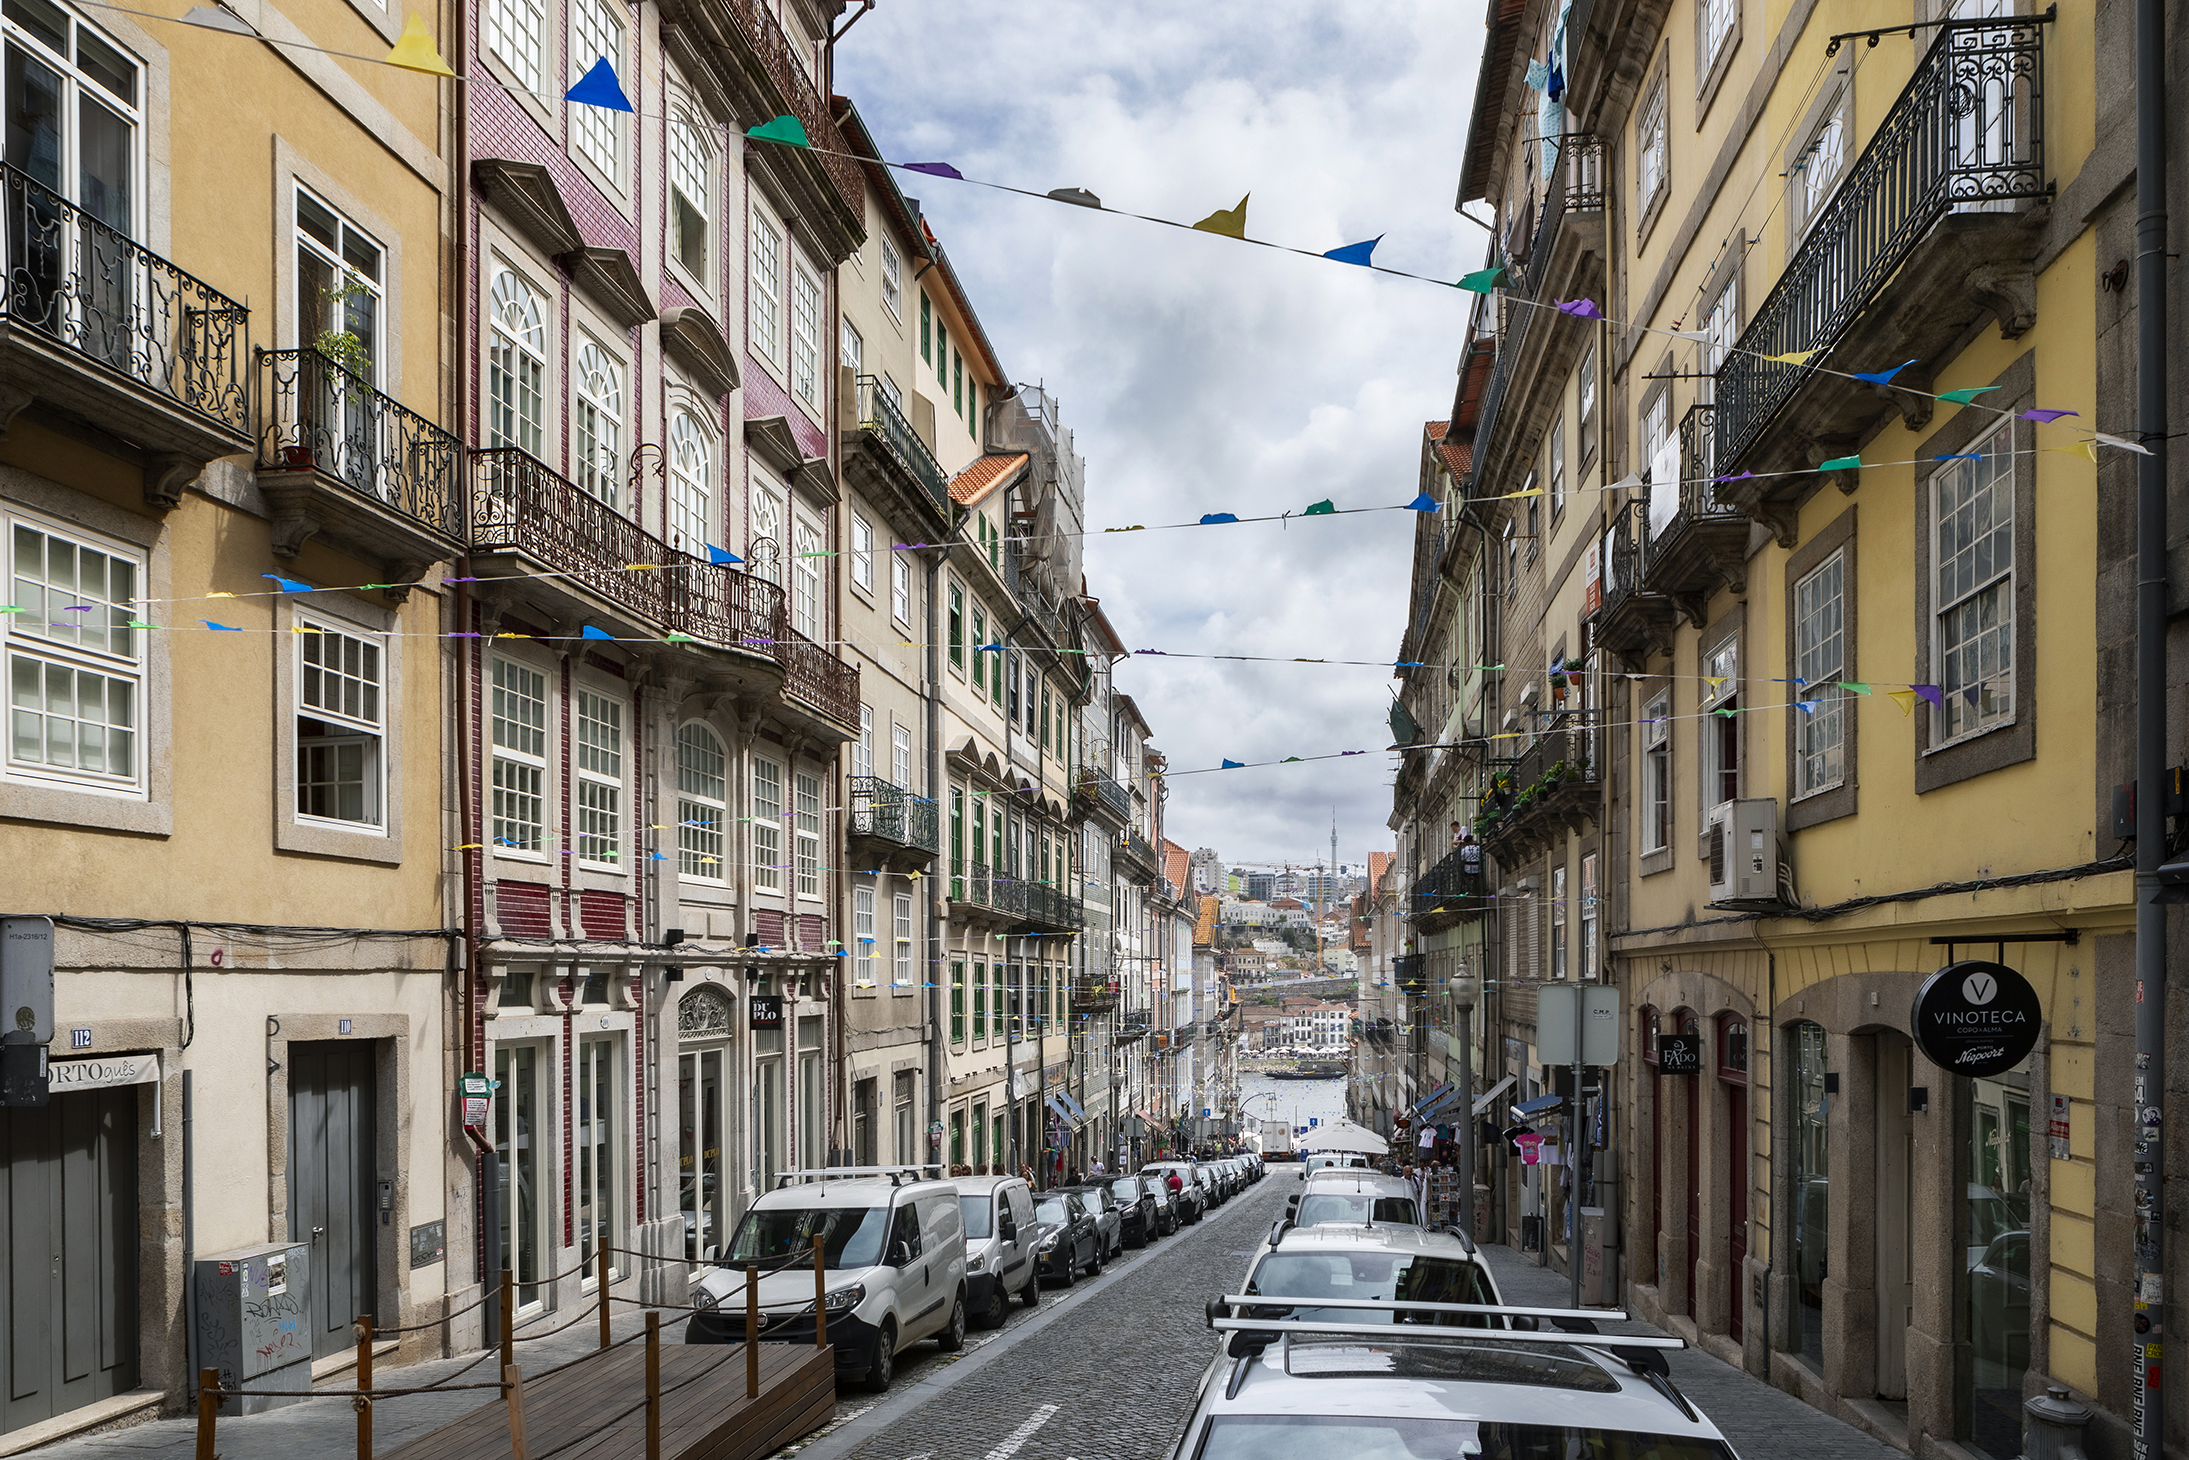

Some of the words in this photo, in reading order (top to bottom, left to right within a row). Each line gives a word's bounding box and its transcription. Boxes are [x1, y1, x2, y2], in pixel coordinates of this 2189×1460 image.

[9, 933, 48, 941] H1a-2316/12
[1970, 979, 1990, 1002] V
[753, 1003, 770, 1012] DU
[753, 1011, 777, 1021] PLO
[1934, 1010, 2026, 1025] VINOTECA
[341, 1020, 351, 1033] 110
[74, 1030, 91, 1046] 112
[1664, 1047, 1696, 1066] FADO
[1955, 1047, 2005, 1065] Niepoort
[49, 1060, 136, 1084] RTOguês
